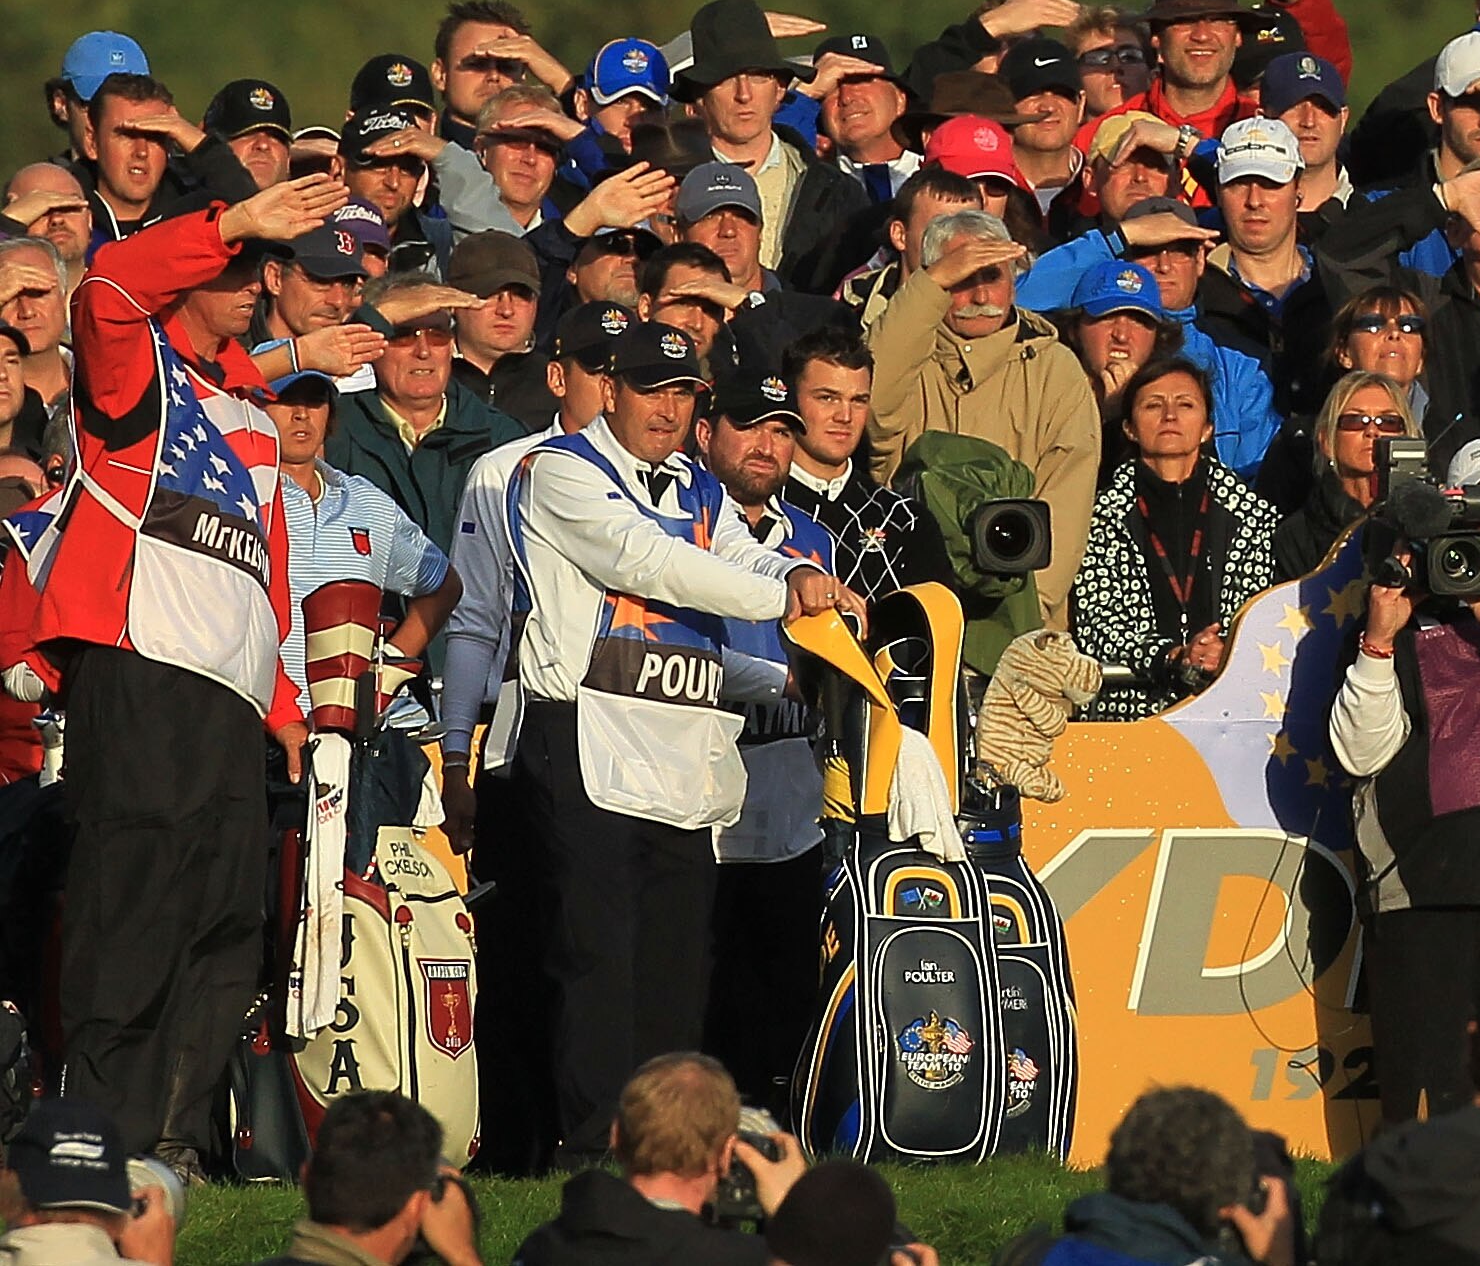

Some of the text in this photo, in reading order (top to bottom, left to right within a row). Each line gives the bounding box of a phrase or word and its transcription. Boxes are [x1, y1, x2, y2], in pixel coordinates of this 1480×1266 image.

[920, 959, 938, 971] Ian
[905, 971, 956, 983] POULTER
[901, 1052, 969, 1064] EUROPEAN
[907, 1061, 941, 1071] TEAM
[1249, 1045, 1382, 1101] 192
